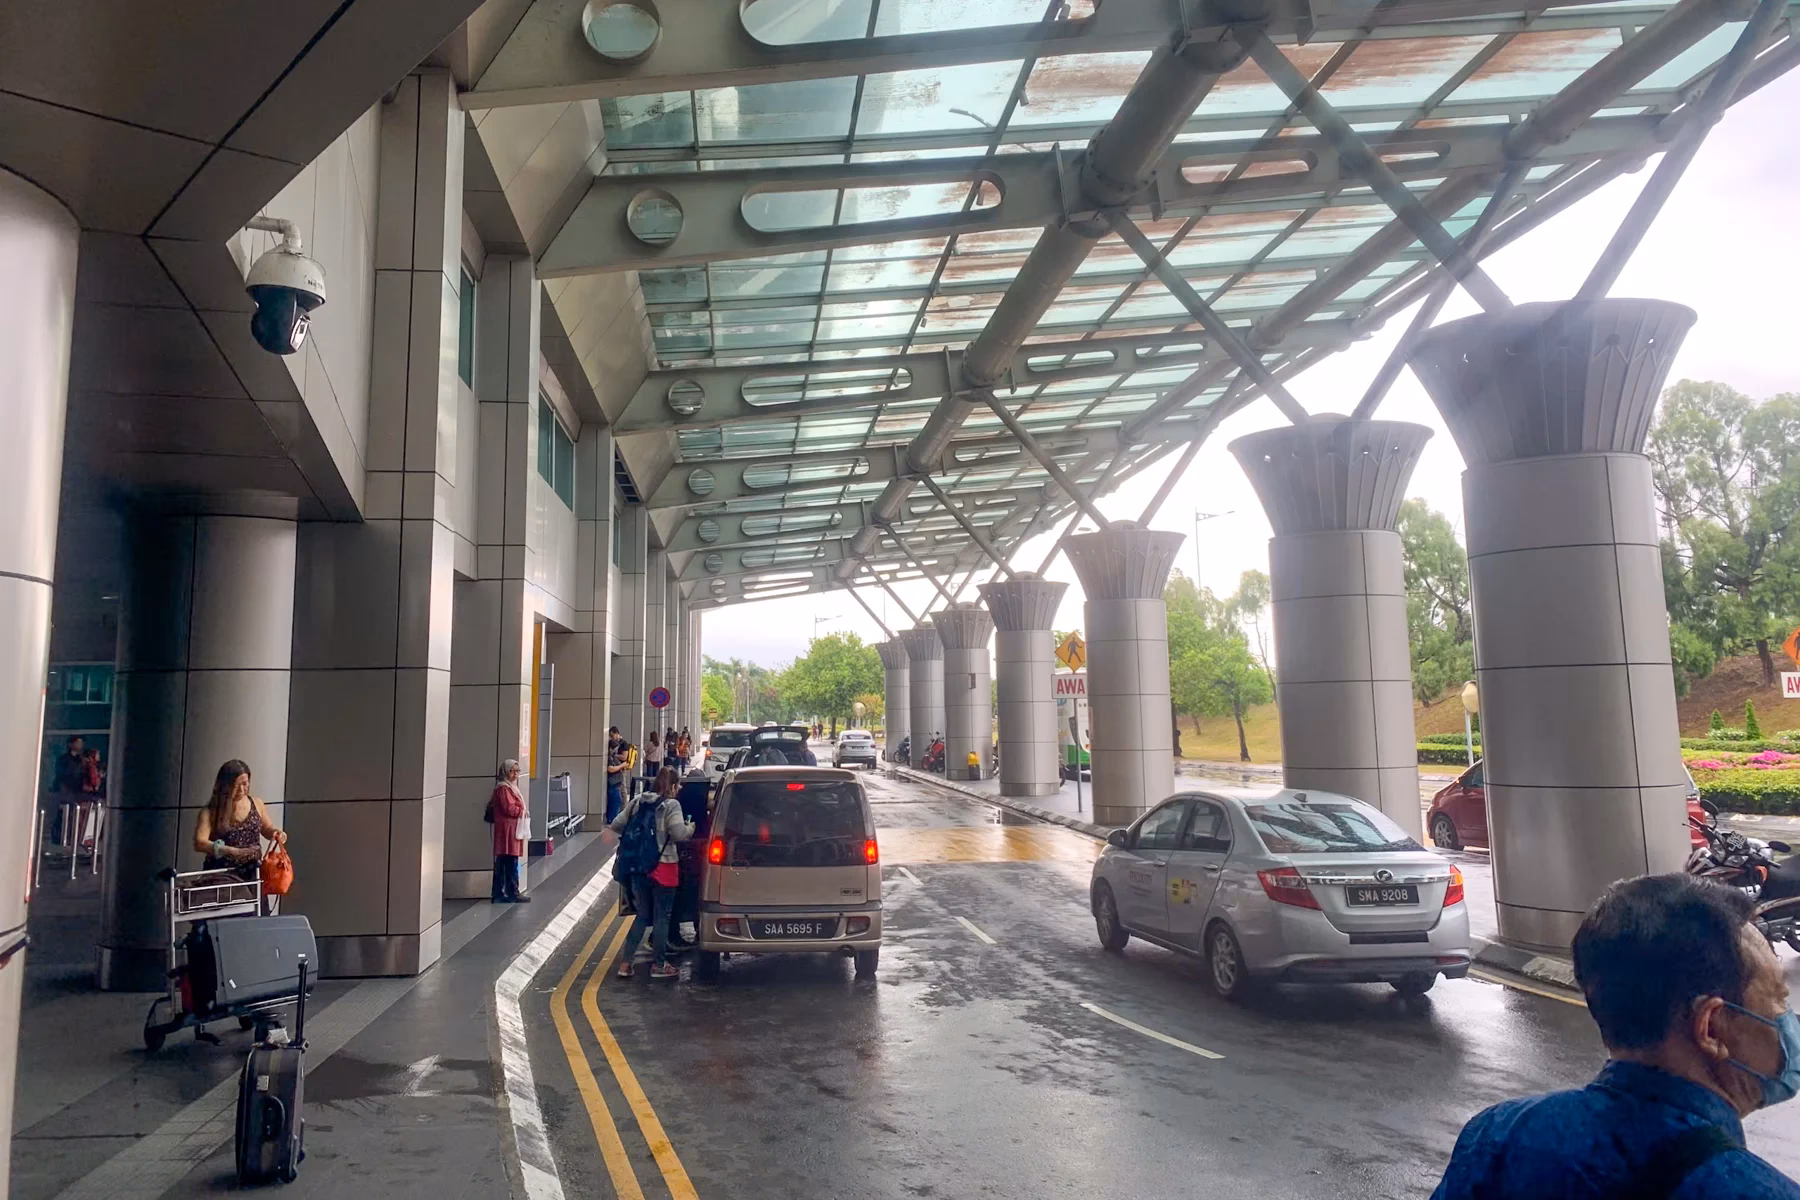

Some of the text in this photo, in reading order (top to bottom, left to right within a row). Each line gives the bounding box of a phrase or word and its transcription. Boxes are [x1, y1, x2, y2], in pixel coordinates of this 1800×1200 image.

[1056, 678, 1086, 695] AWA
[1358, 888, 1409, 902] SMA 9208
[764, 923, 823, 935] SAA 5695 F
